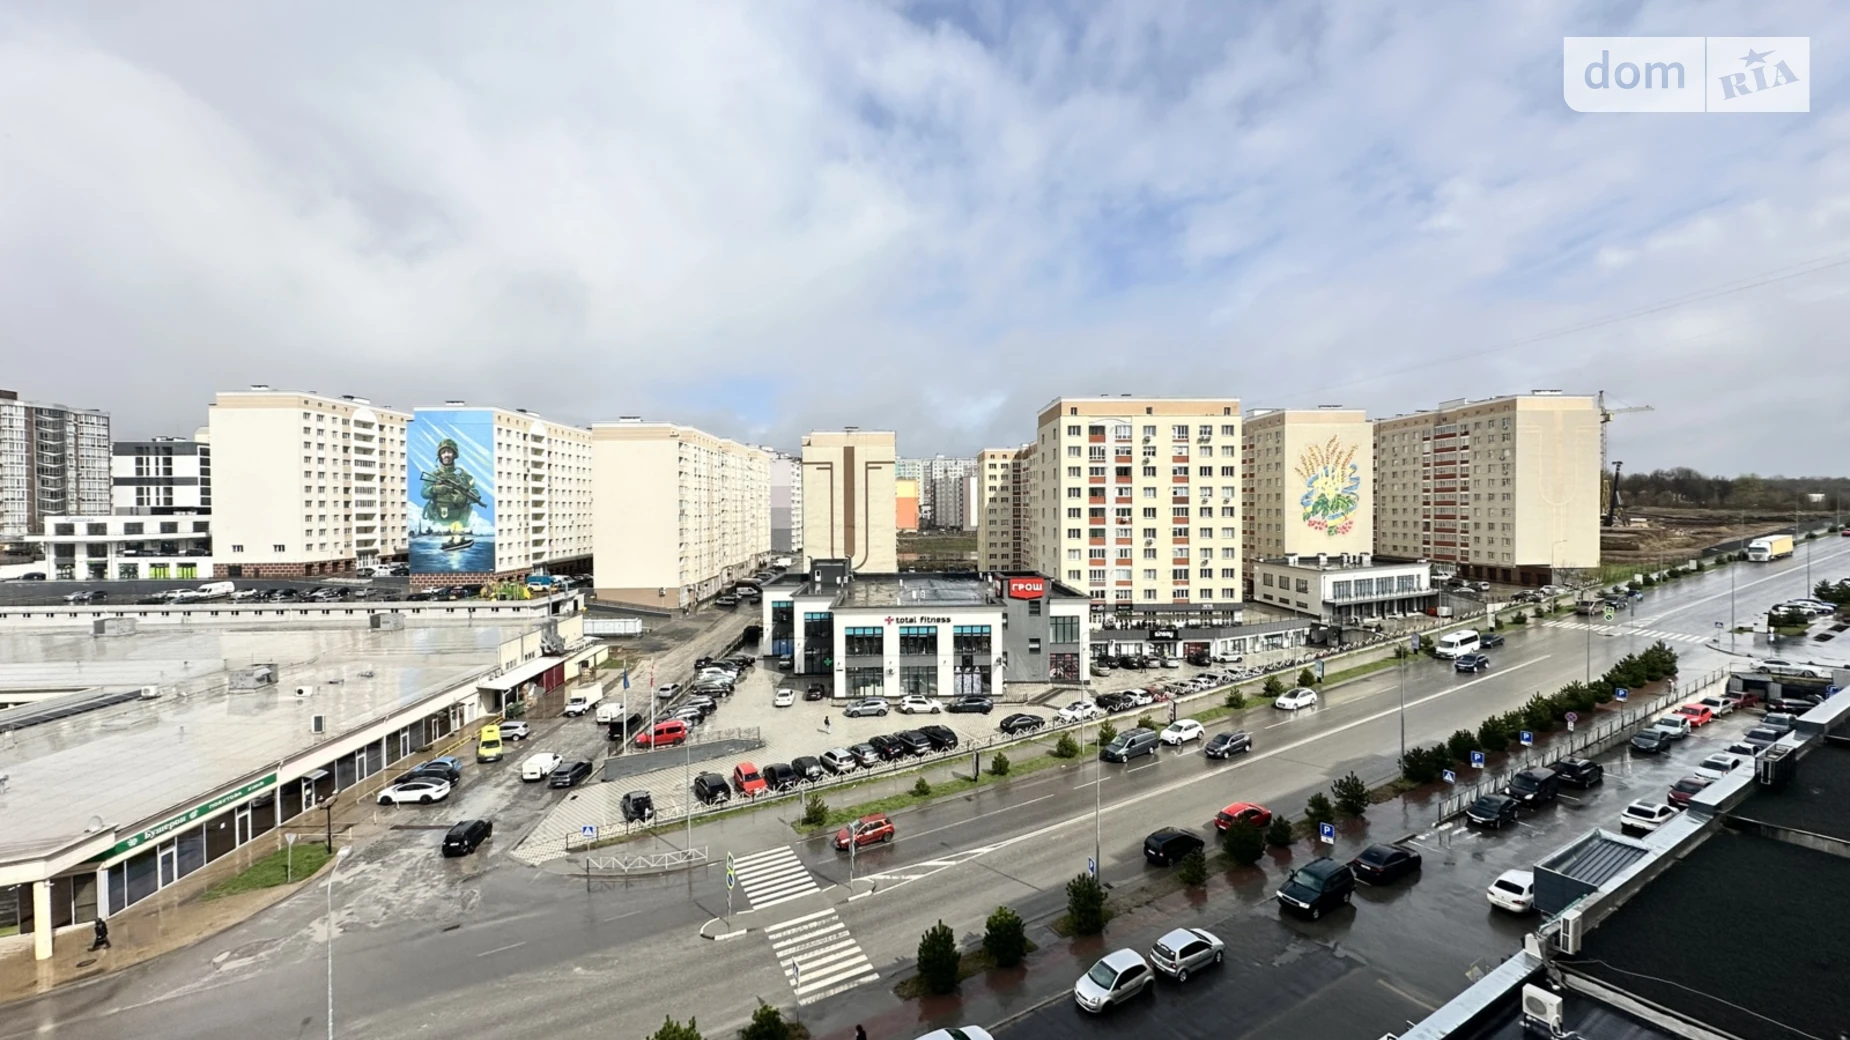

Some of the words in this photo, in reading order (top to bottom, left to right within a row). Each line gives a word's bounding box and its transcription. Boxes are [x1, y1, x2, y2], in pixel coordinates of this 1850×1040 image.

[1012, 583, 1042, 592] ГРОШ
[896, 616, 917, 624] total
[920, 615, 952, 624] fitness
